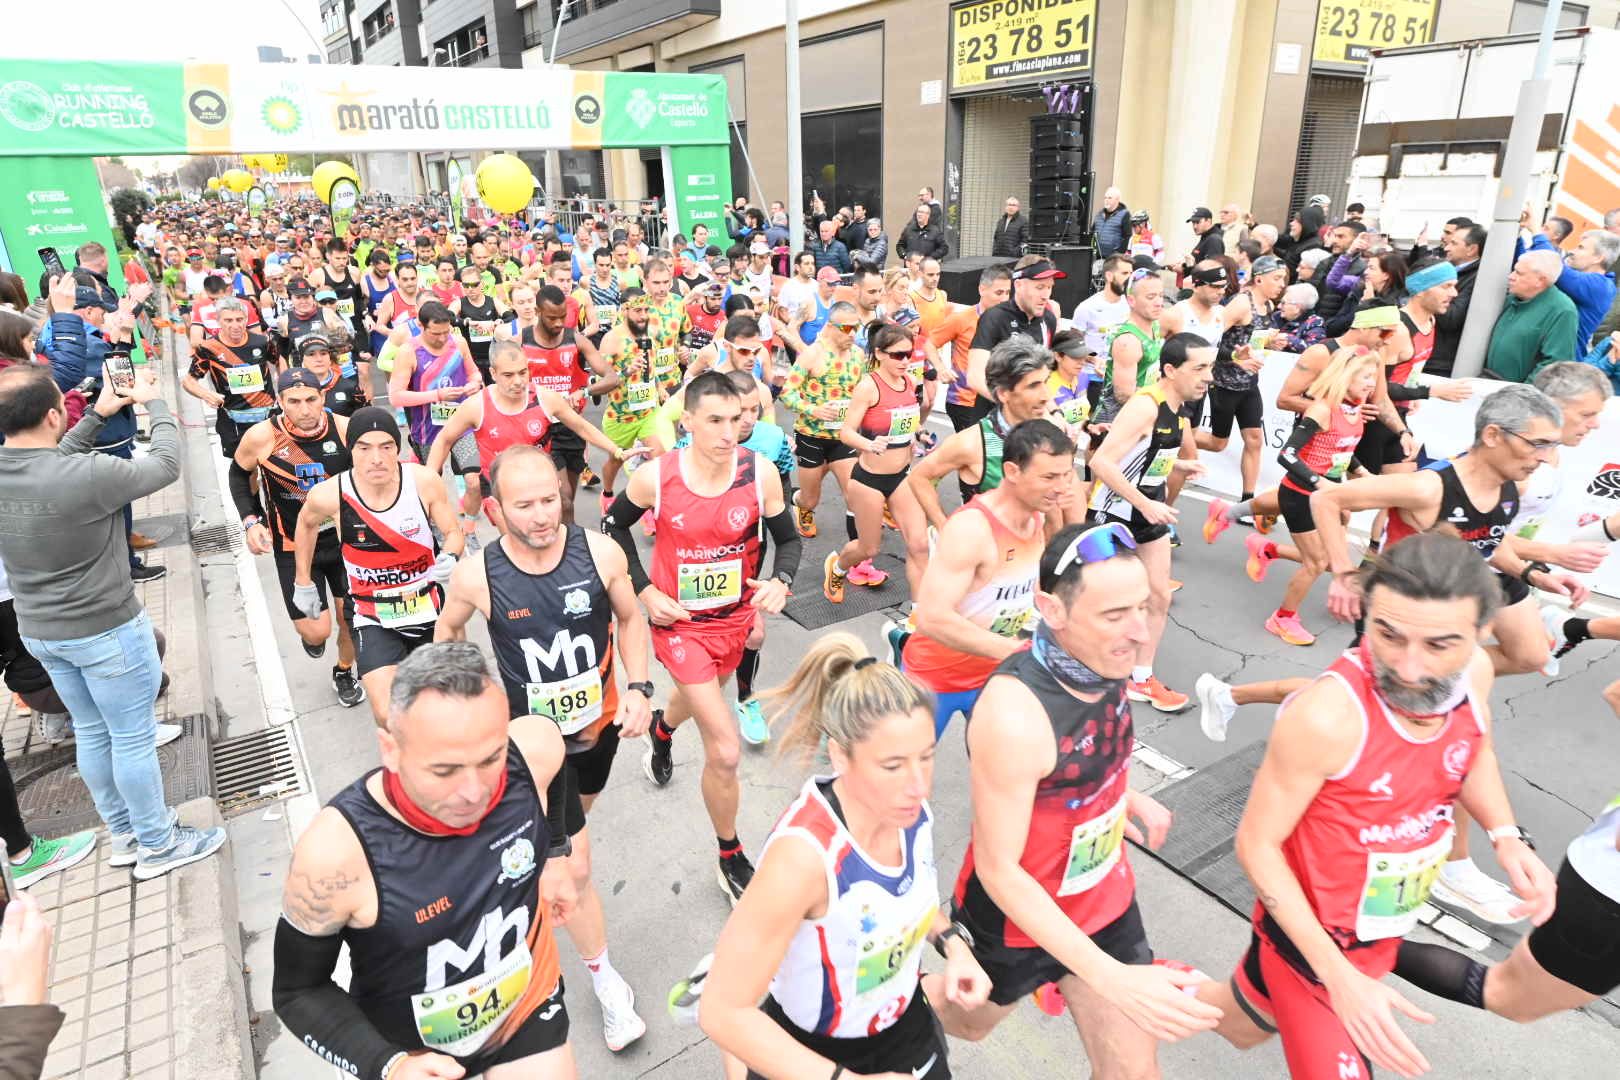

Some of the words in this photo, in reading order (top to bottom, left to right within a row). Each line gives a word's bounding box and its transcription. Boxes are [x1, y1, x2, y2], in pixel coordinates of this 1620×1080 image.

[1329, 6, 1360, 38] 23
[1369, 11, 1397, 42] 78
[1403, 17, 1429, 44] 51
[967, 33, 998, 64] 23
[1009, 24, 1043, 56] 78
[1055, 14, 1090, 48] 51
[54, 93, 148, 112] RUNNING
[658, 100, 709, 117] Castelló
[337, 98, 440, 131] marató
[443, 100, 551, 130] CASTELLÓ
[238, 373, 253, 384] 73
[636, 388, 651, 398] 132
[900, 417, 913, 430] 65
[366, 562, 428, 587] ARROYO
[692, 573, 727, 593] 102
[695, 590, 722, 599] SERNA
[507, 608, 532, 620] ULEVEL
[545, 690, 588, 716] 198
[414, 896, 454, 925] ULEVEL
[456, 987, 502, 1028] 94
[304, 1034, 358, 1075] CREANDO
